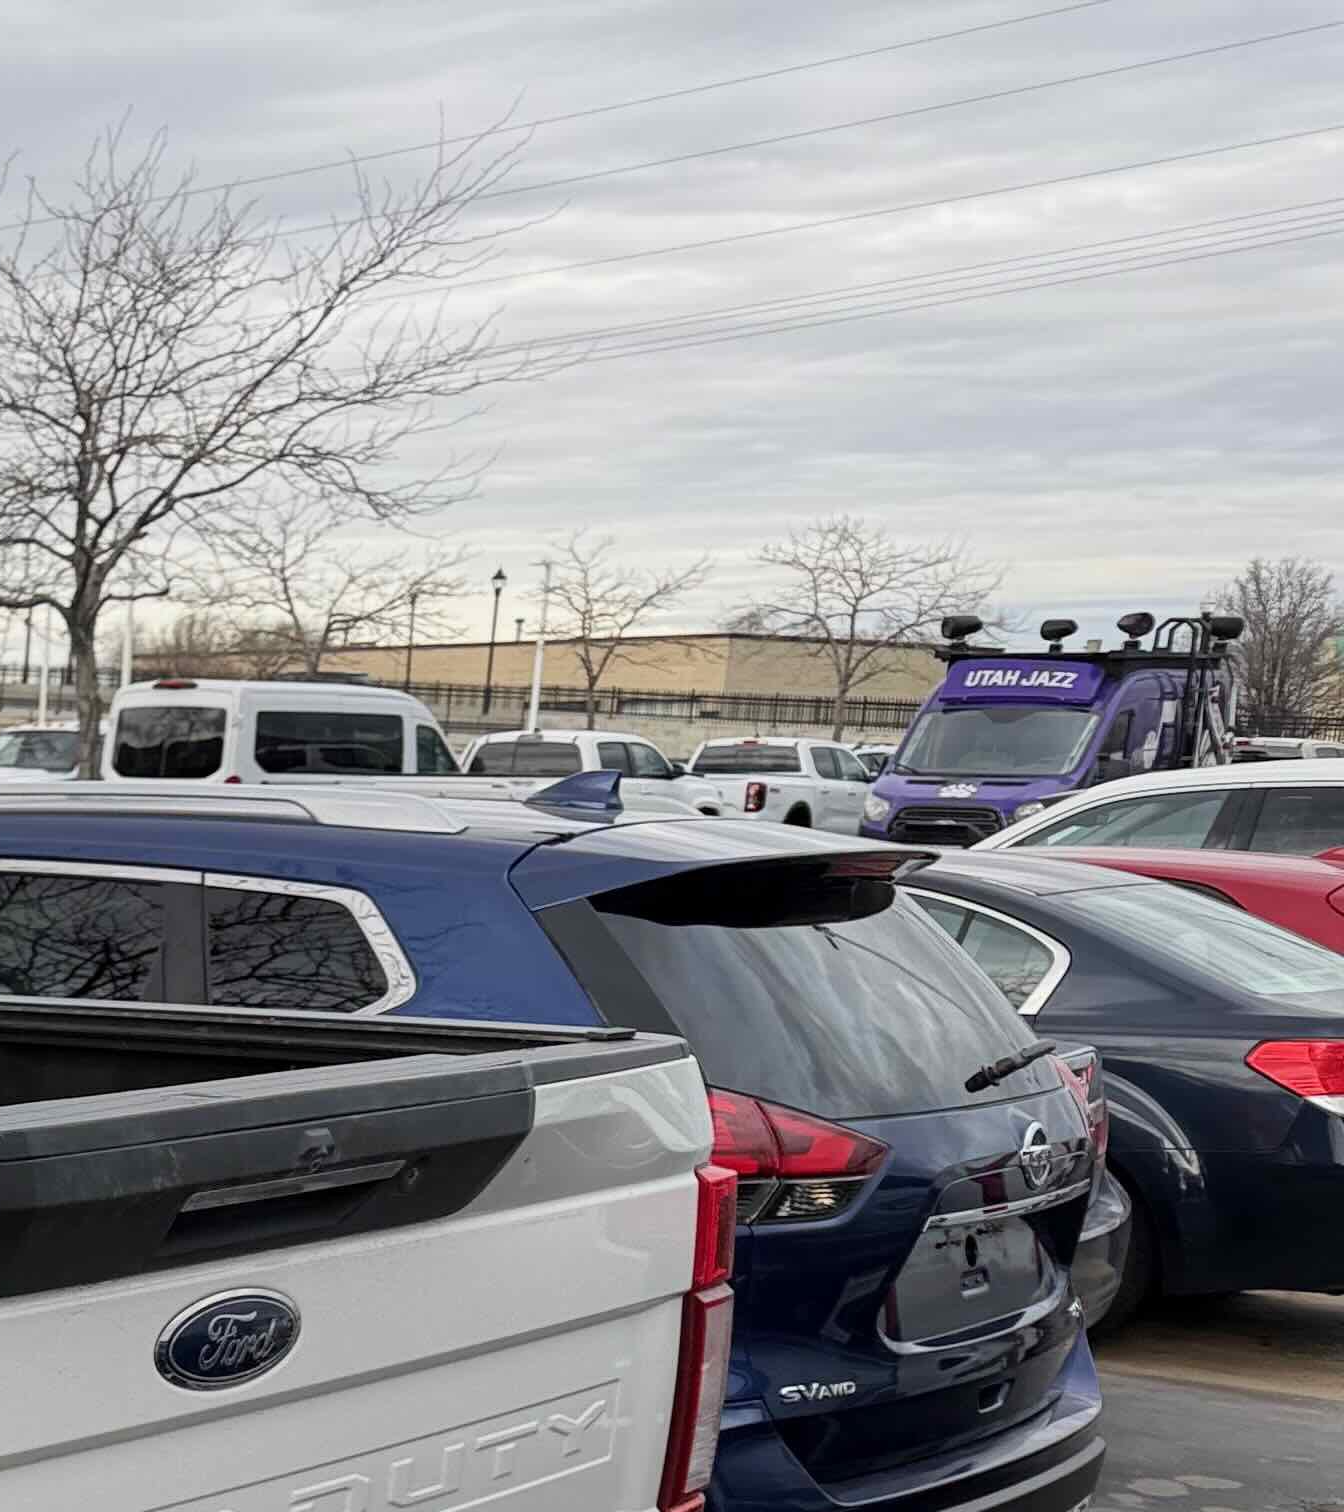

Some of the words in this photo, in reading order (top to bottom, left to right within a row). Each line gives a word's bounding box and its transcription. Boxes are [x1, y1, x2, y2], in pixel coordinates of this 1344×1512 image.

[964, 669, 1021, 687] UTAH
[1020, 670, 1079, 689] JAZZ
[198, 1310, 279, 1371] Ford
